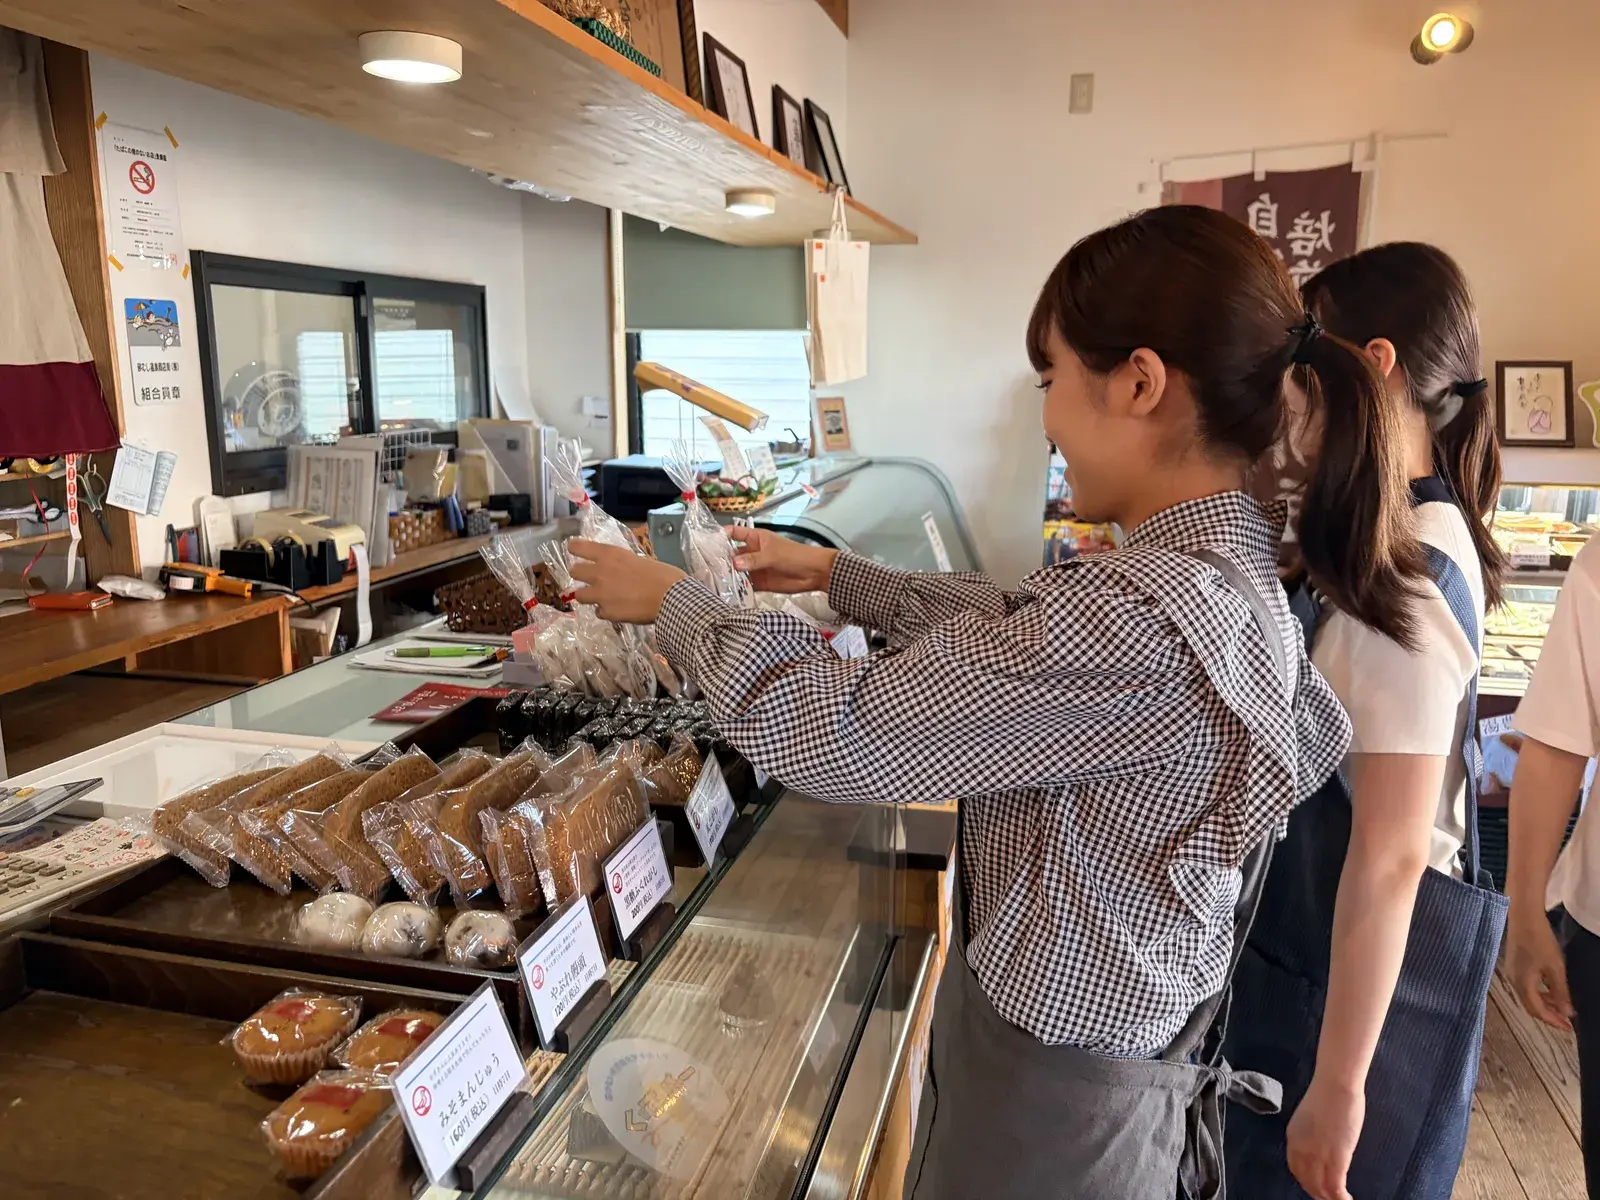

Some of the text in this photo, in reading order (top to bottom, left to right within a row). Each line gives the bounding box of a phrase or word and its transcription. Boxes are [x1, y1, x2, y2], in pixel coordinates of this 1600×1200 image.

[140, 386, 181, 401] 組合員章
[548, 951, 586, 1004] やぶれ饅頭
[439, 1052, 499, 1128] みそまんじゅう
